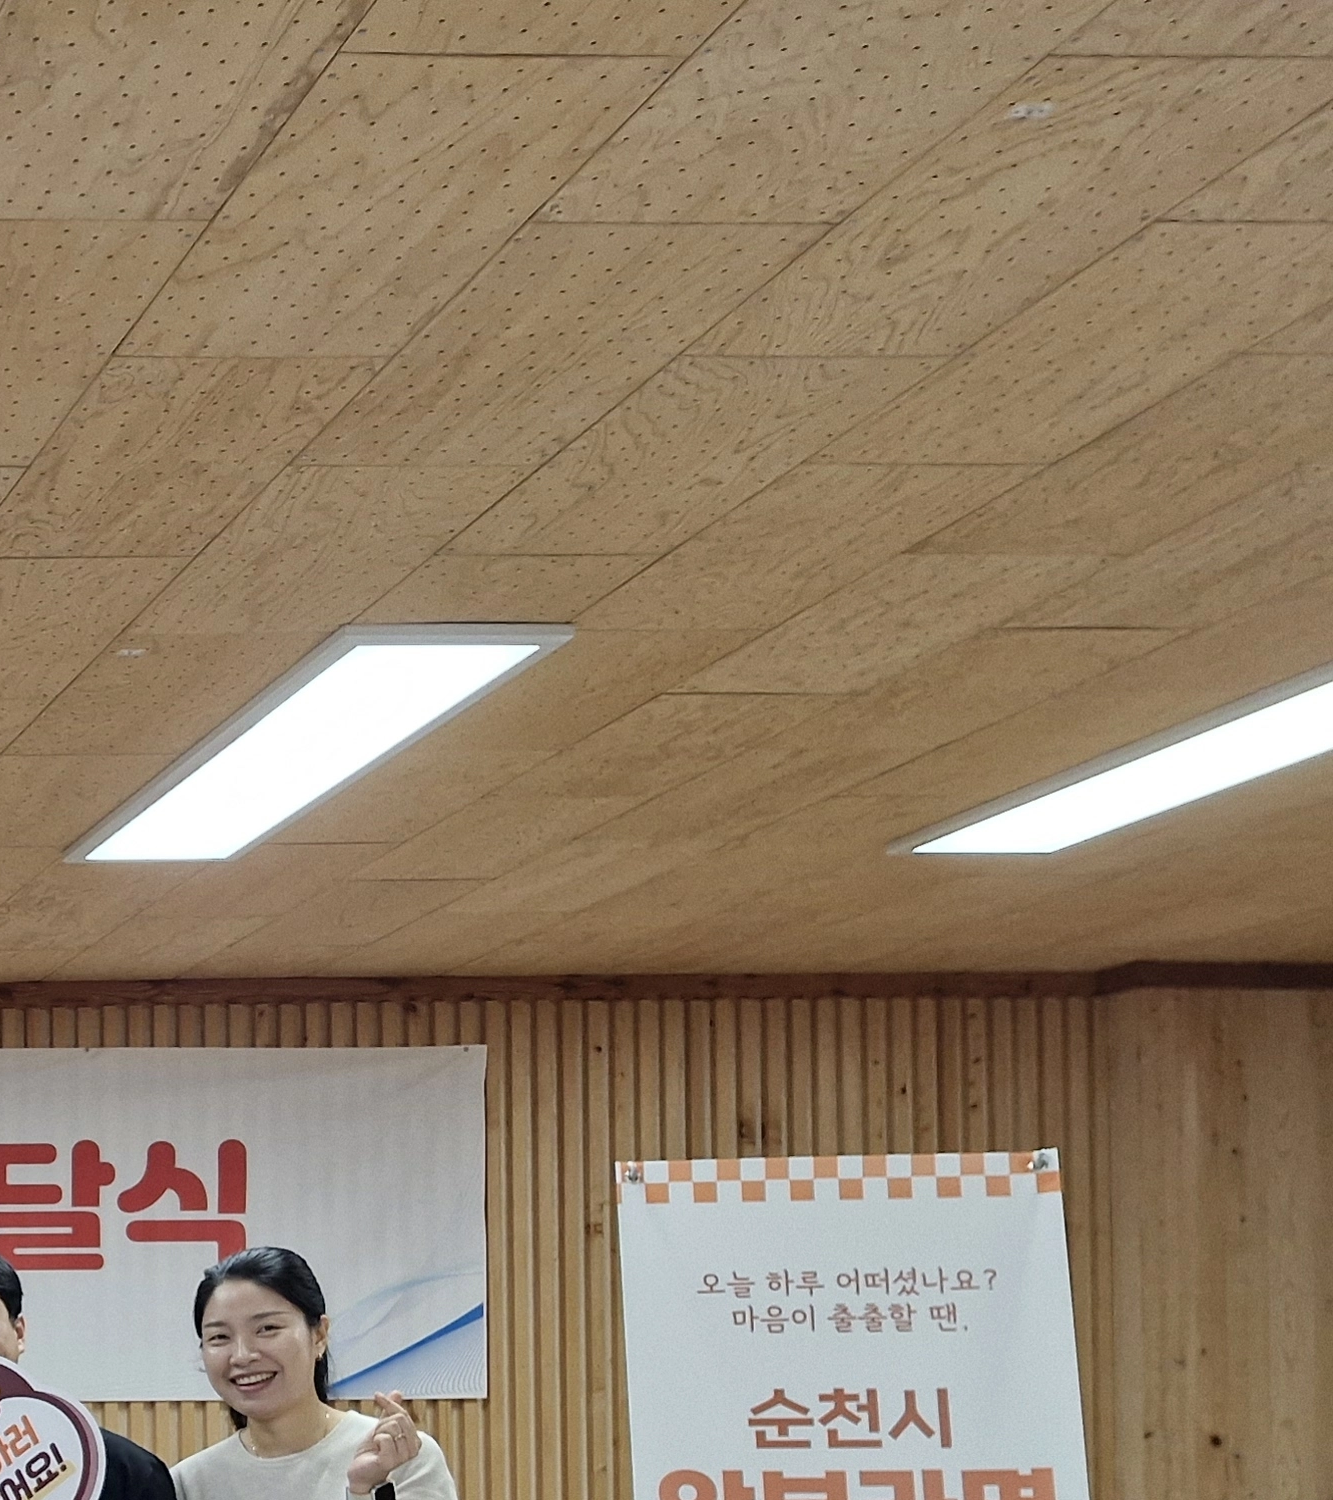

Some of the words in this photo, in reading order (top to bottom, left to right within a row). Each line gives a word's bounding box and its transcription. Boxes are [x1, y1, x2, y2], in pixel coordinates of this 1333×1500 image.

[697, 1271, 755, 1298] 오늘
[766, 1268, 825, 1296] 하루
[837, 1266, 997, 1297] 어떠셨나요?
[733, 1304, 815, 1334] 마음이
[827, 1302, 917, 1333] 출출할
[747, 1387, 953, 1449] 순천시
